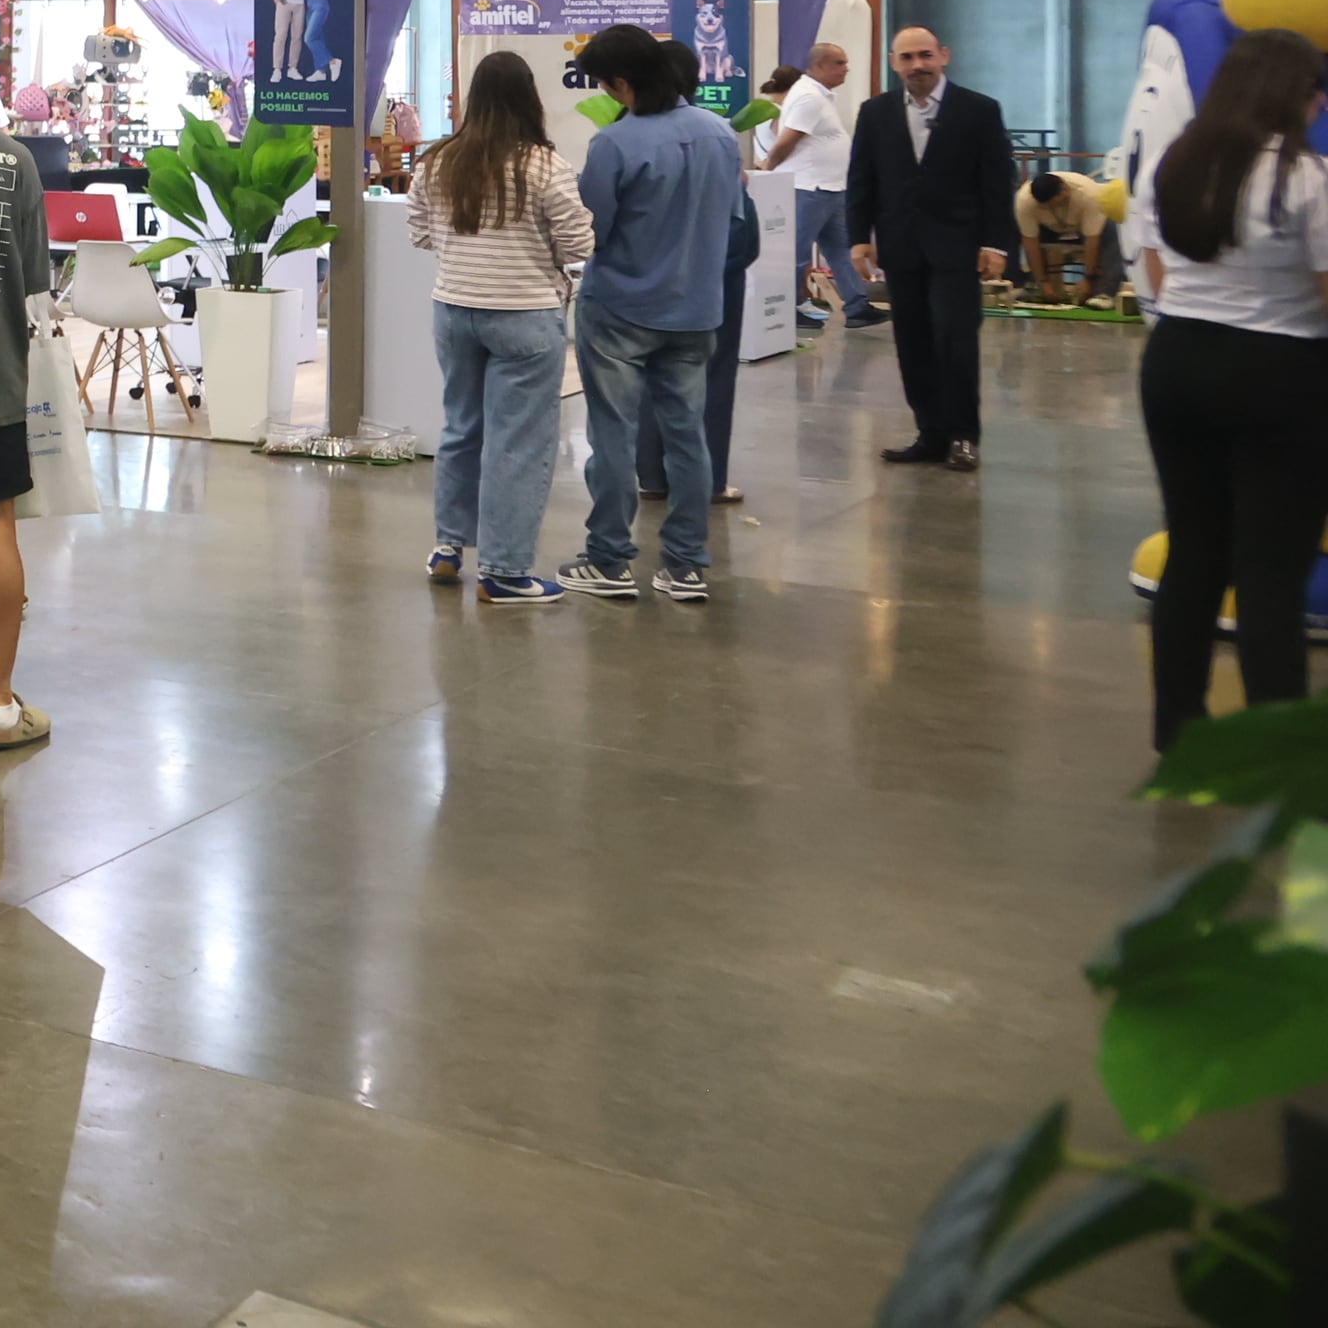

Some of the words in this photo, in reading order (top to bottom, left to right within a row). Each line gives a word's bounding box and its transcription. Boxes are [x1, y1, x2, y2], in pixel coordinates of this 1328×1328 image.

[470, 4, 534, 26] amifiel
[260, 91, 274, 100] LO
[276, 92, 330, 102] HACEMOS
[260, 103, 304, 112] POSIBLE
